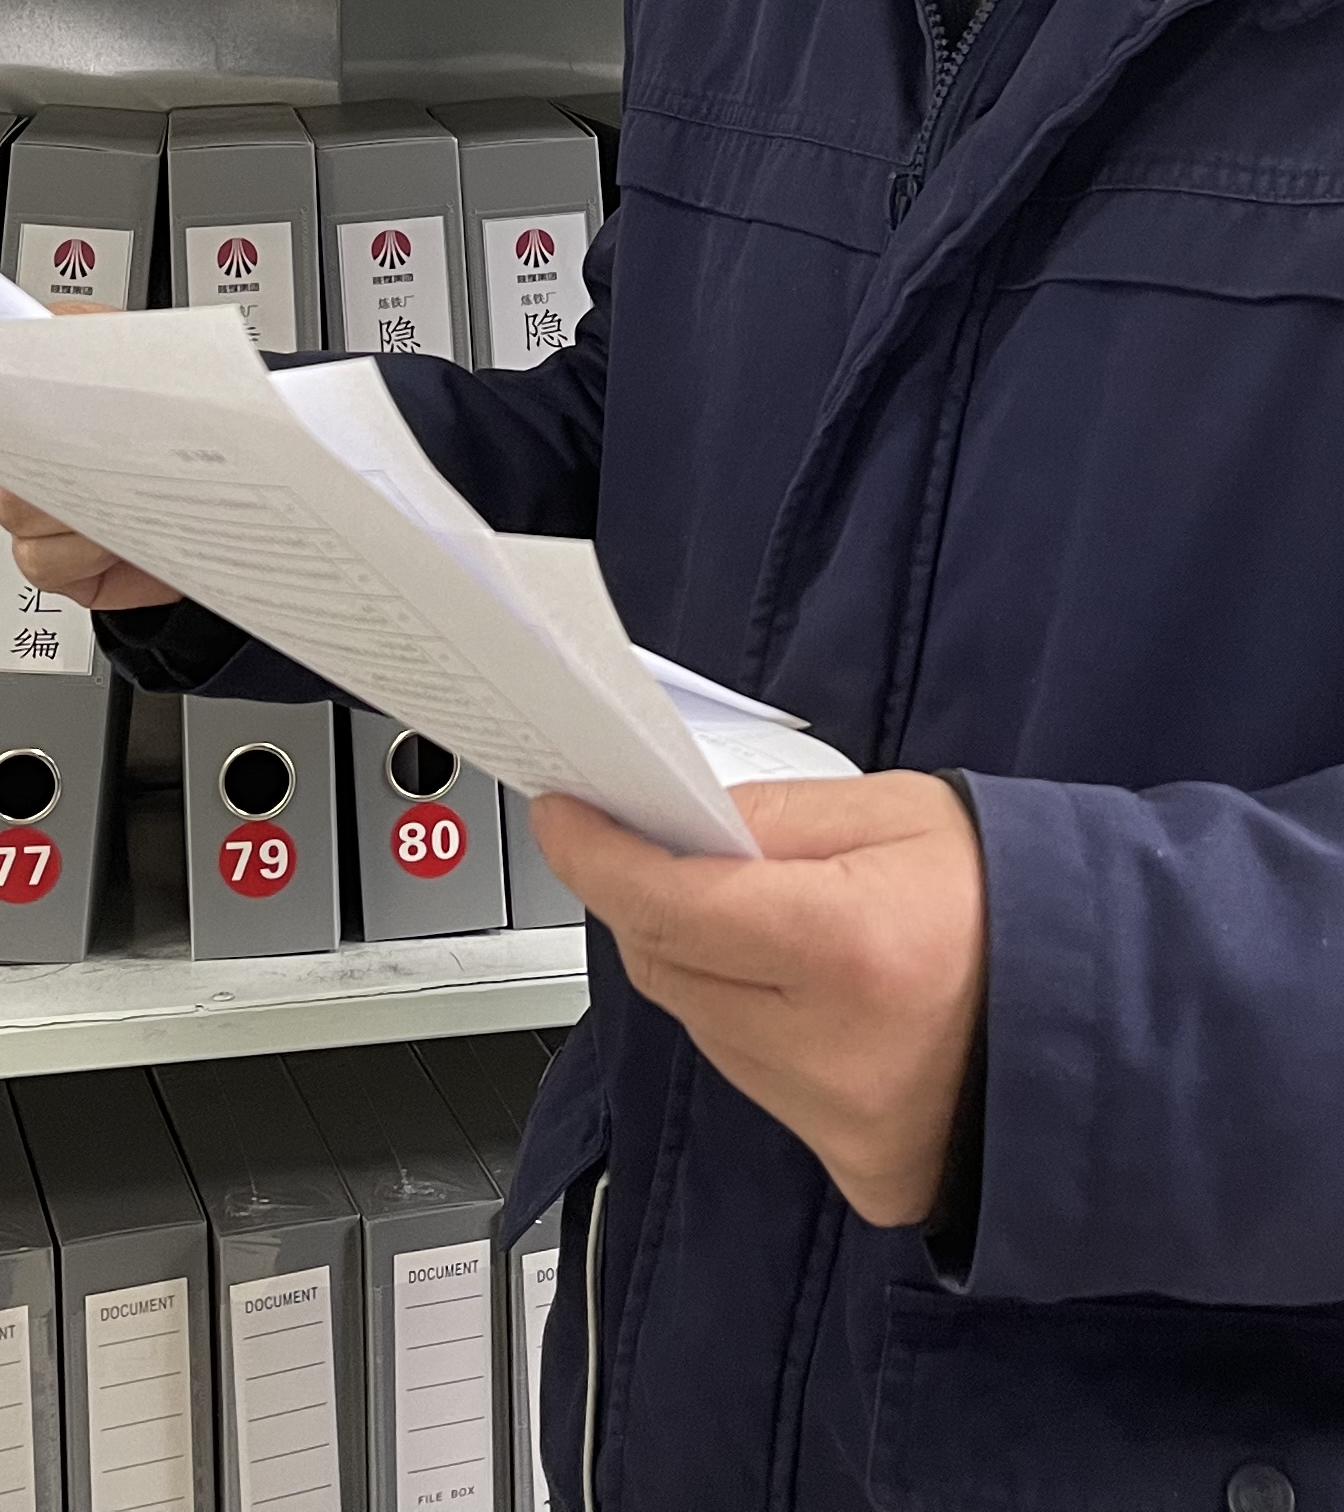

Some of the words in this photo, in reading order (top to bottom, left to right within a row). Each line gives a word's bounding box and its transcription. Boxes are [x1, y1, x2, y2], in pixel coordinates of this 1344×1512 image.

[378, 294, 416, 311] 炼铁厂
[520, 291, 556, 306] 炼铁厂
[524, 309, 568, 351] 隐
[399, 821, 459, 861] 80
[226, 840, 287, 880] 79
[408, 1259, 480, 1284] DOCUMENT
[100, 1295, 176, 1322] DOCUMENT
[244, 1287, 319, 1314] DOCUMENT
[418, 1491, 443, 1506] FILE
[450, 1486, 476, 1499] BOX
